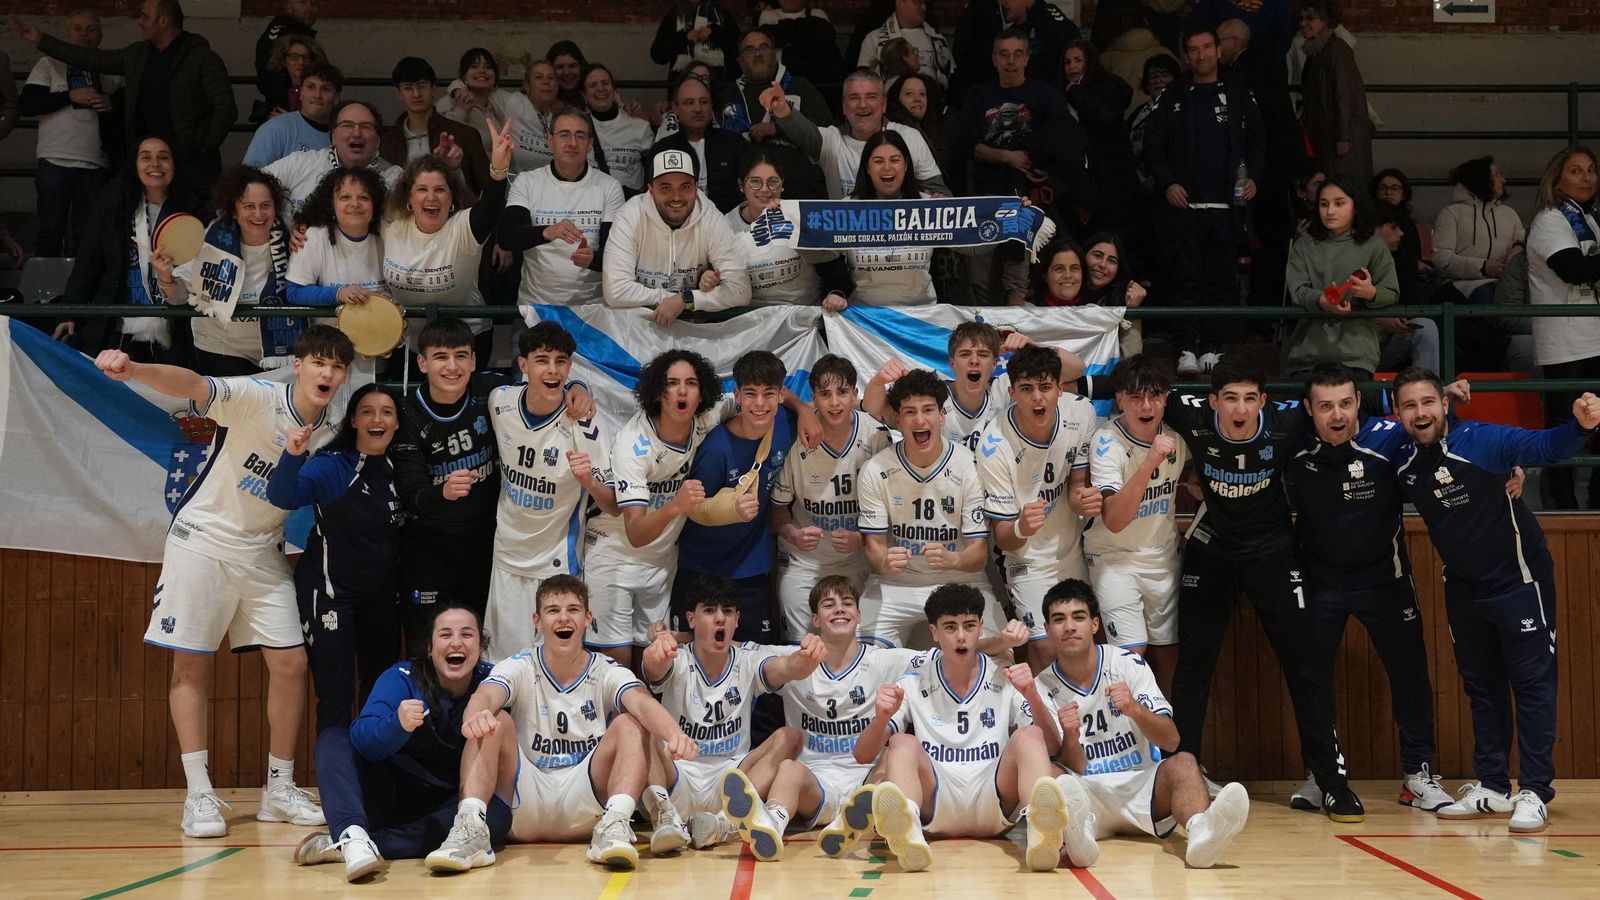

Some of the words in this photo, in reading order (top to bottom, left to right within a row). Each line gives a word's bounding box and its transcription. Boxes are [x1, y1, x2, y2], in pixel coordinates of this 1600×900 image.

[806, 205, 978, 232] #SOMOSGALICIA
[834, 234, 857, 243] SOMOS
[858, 233, 886, 244] CORAXE,
[888, 231, 913, 242] PAIXÓN
[920, 232, 954, 242] RESPECTO
[447, 428, 474, 456] 55
[517, 445, 536, 469] 19
[1234, 453, 1247, 470] 1
[1043, 462, 1055, 484] 8
[1203, 462, 1276, 485] Balonmán
[830, 473, 852, 497] 15
[1209, 478, 1272, 499] #Galego
[912, 498, 935, 521] 18
[1292, 586, 1306, 609] 1
[703, 700, 725, 723] 20
[826, 698, 838, 719] 3
[556, 711, 569, 734] 9
[957, 711, 969, 734] 5
[1082, 709, 1108, 738] 24
